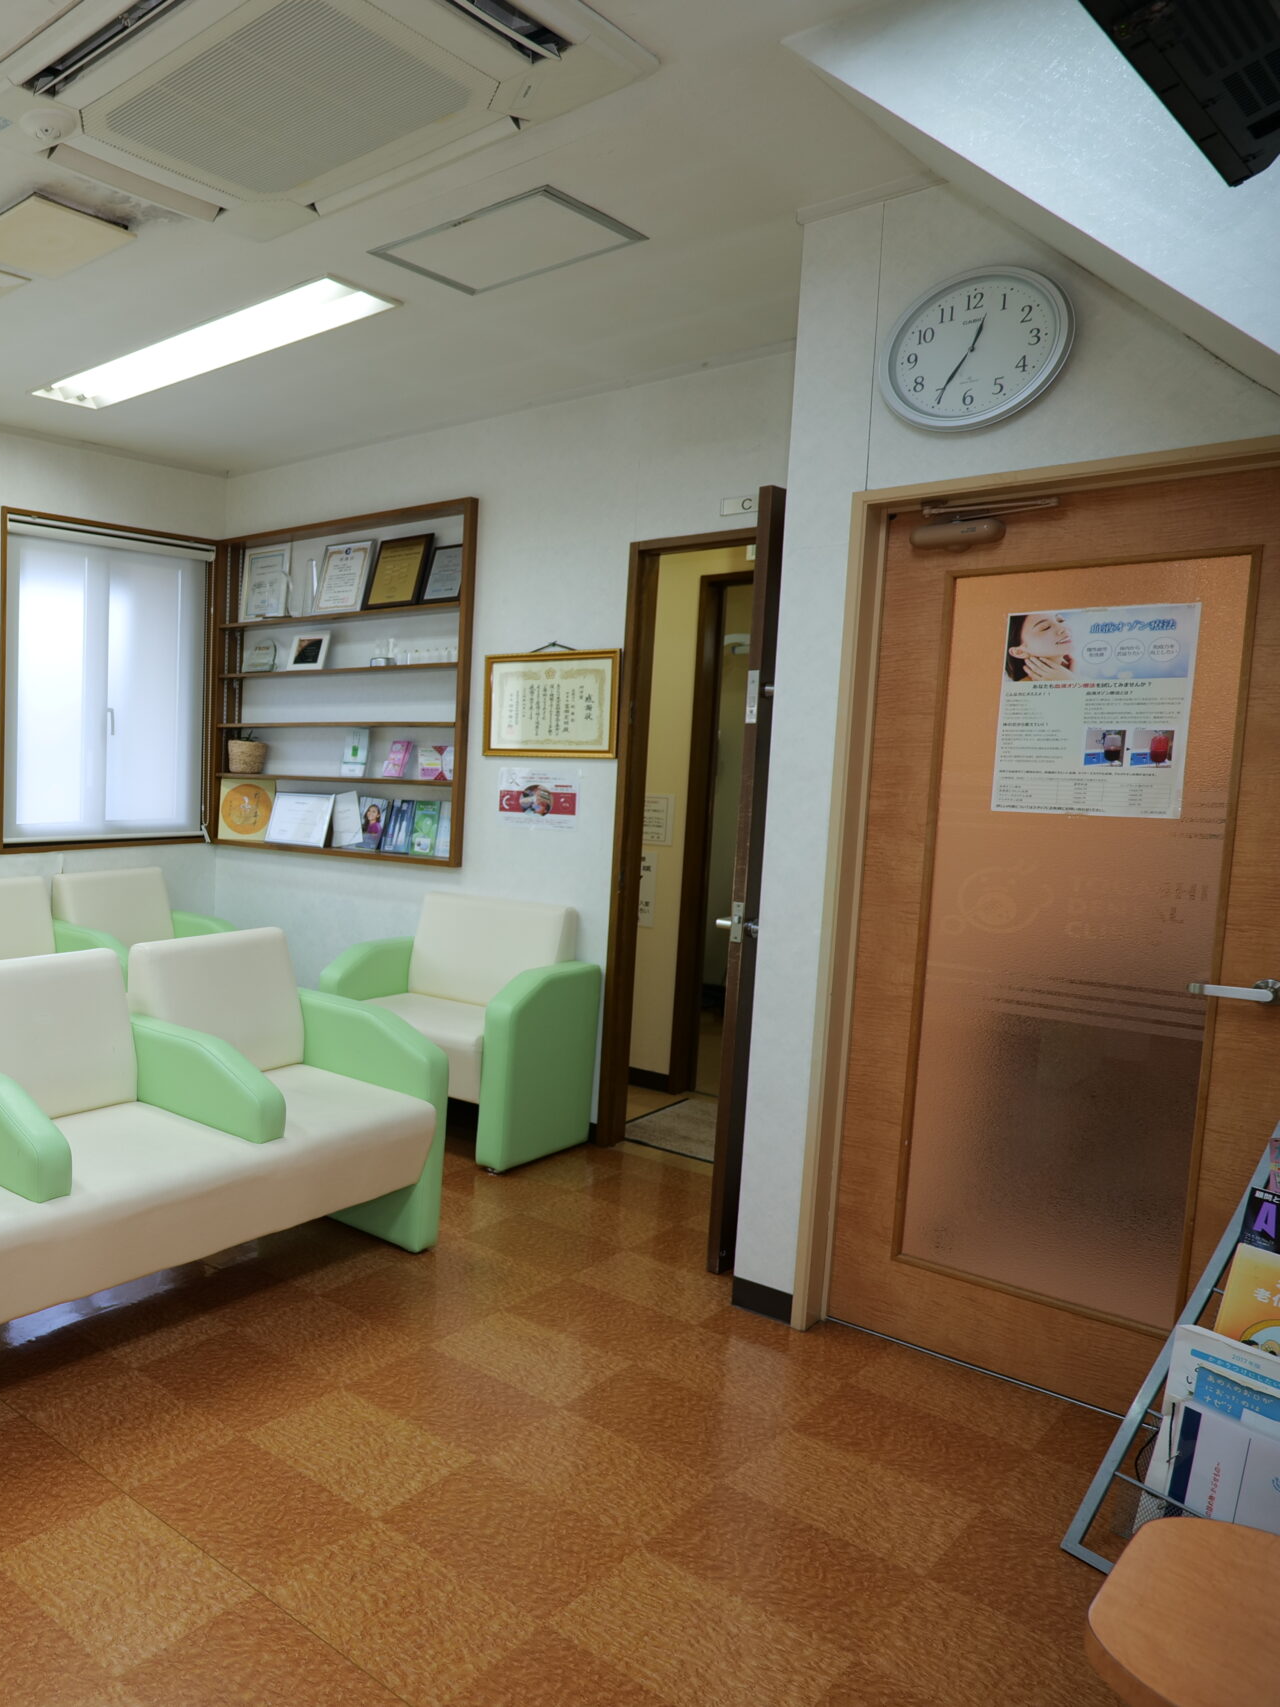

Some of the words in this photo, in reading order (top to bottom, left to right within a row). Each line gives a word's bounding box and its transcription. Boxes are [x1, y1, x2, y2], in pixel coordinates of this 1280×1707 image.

[965, 292, 984, 311] 12
[1000, 293, 1007, 311] 1
[938, 306, 955, 324] 11
[1020, 305, 1033, 323] 2
[917, 327, 935, 346] 10
[1028, 328, 1041, 346] 3
[907, 353, 918, 369] 9
[1015, 355, 1028, 372] 4
[913, 376, 925, 393] 8
[992, 376, 1005, 395] 5
[935, 387, 947, 405] 7
[962, 389, 974, 406] 6
[741, 498, 752, 511] C
[1089, 618, 1177, 634] 血液オゾン療法
